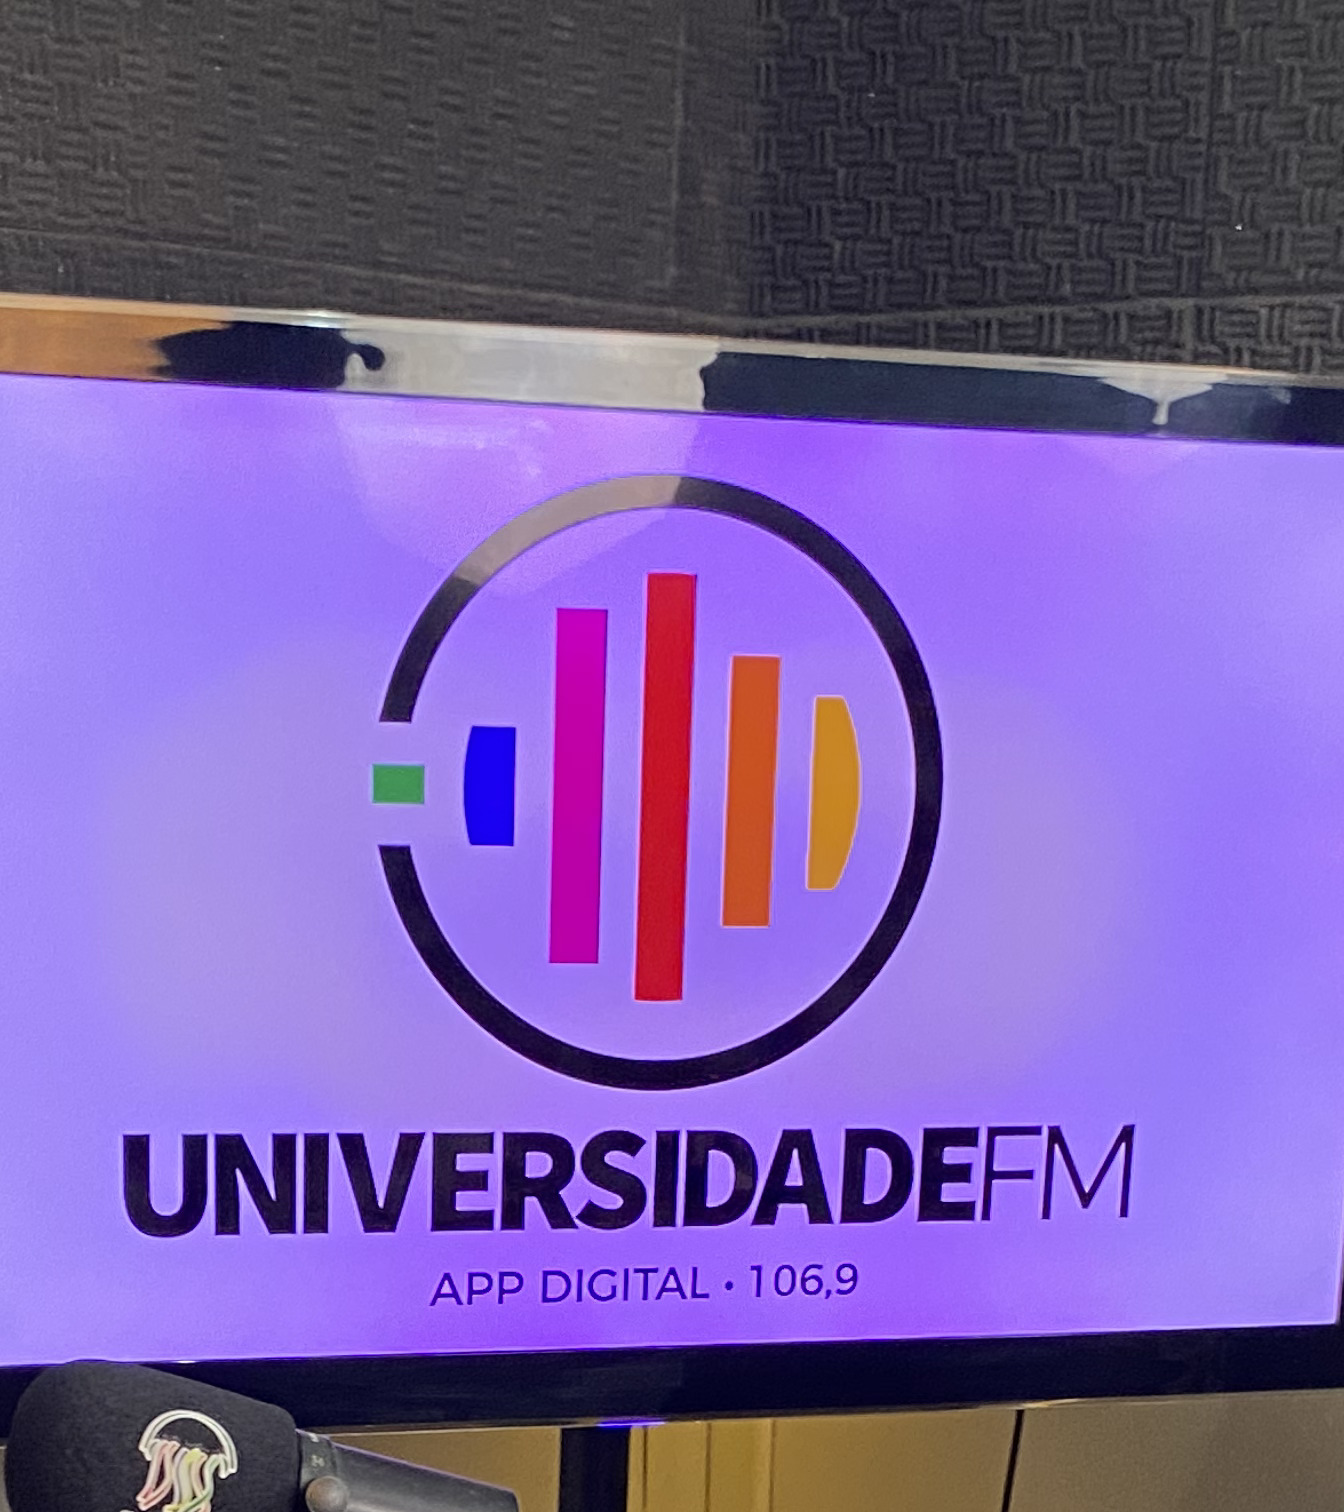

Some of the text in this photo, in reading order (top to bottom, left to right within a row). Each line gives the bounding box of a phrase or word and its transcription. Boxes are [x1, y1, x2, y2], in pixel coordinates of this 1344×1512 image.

[121, 1123, 1136, 1238] UNIVERSIDADEFM
[429, 1262, 859, 1307] APP DIGITAL 106,9
